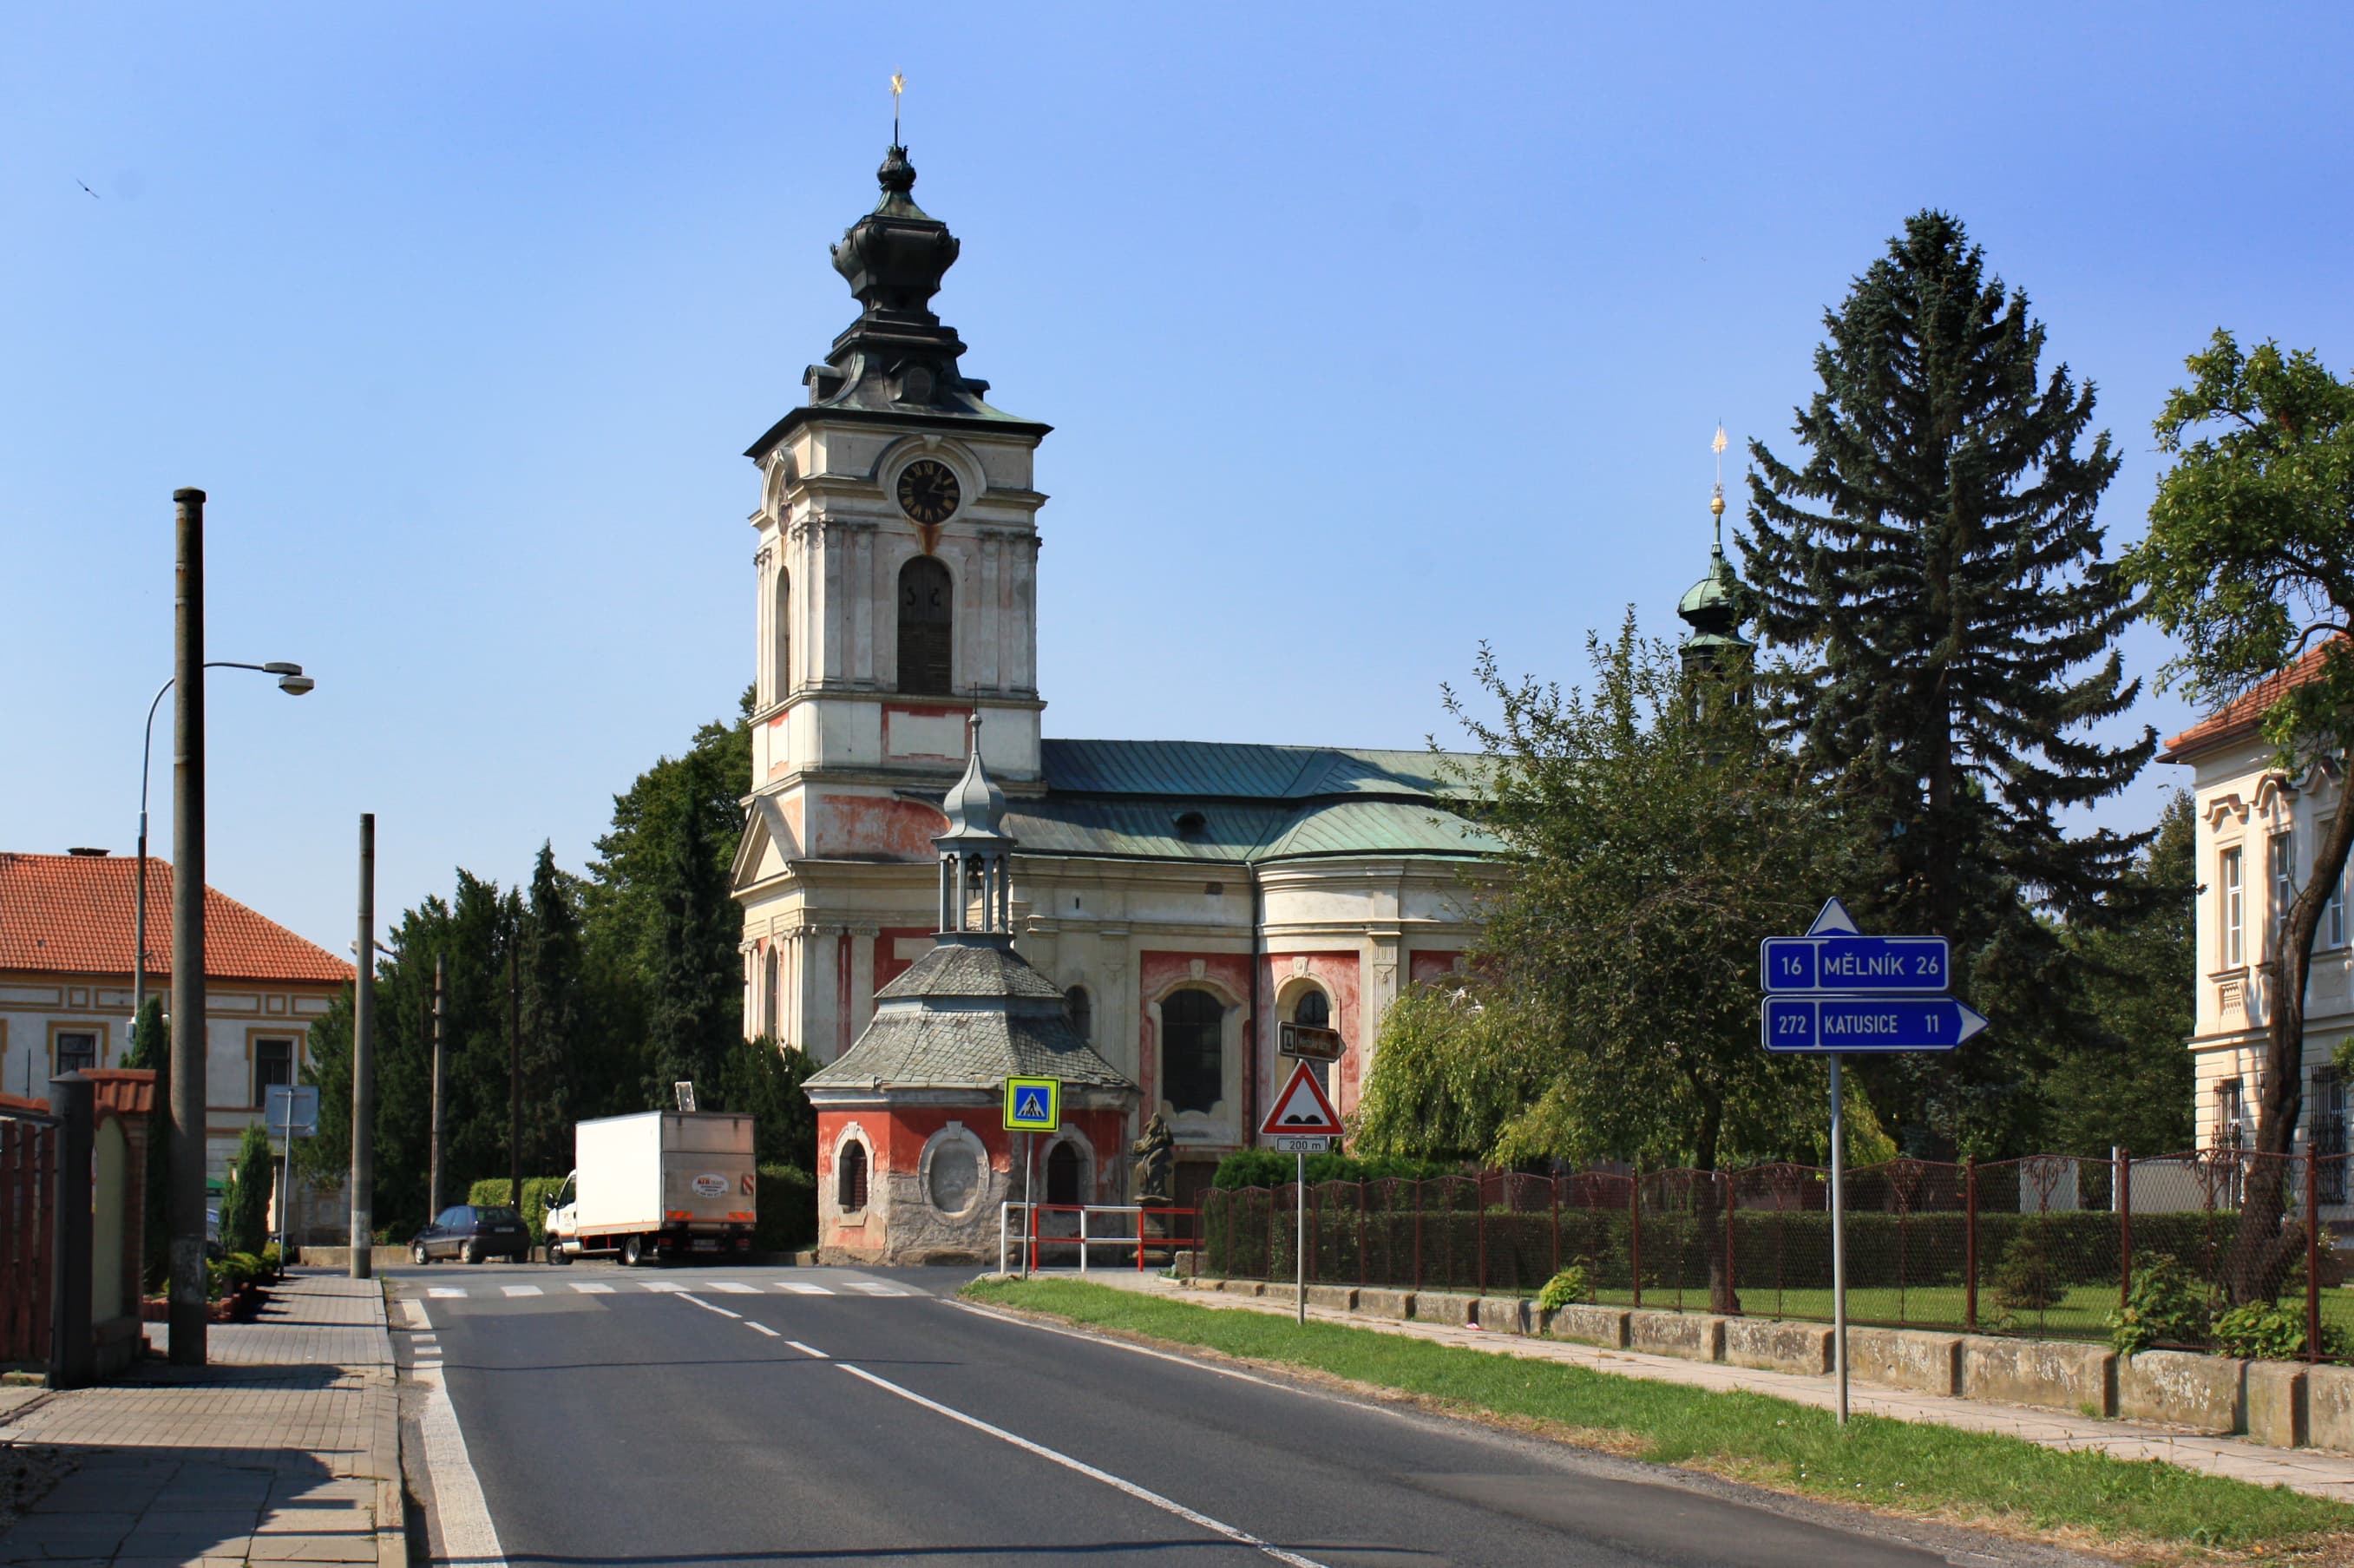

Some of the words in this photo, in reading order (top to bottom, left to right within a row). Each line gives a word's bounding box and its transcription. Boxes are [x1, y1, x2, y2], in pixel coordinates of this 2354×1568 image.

[1781, 956, 1802, 975] 16
[1825, 952, 1905, 975] MĚLNÍK
[1916, 956, 1939, 974] 26
[1779, 1014, 1806, 1034] 272
[1825, 1014, 1898, 1034] KATUSICE
[1925, 1014, 1939, 1033] 11
[1289, 1140, 1308, 1150] 200
